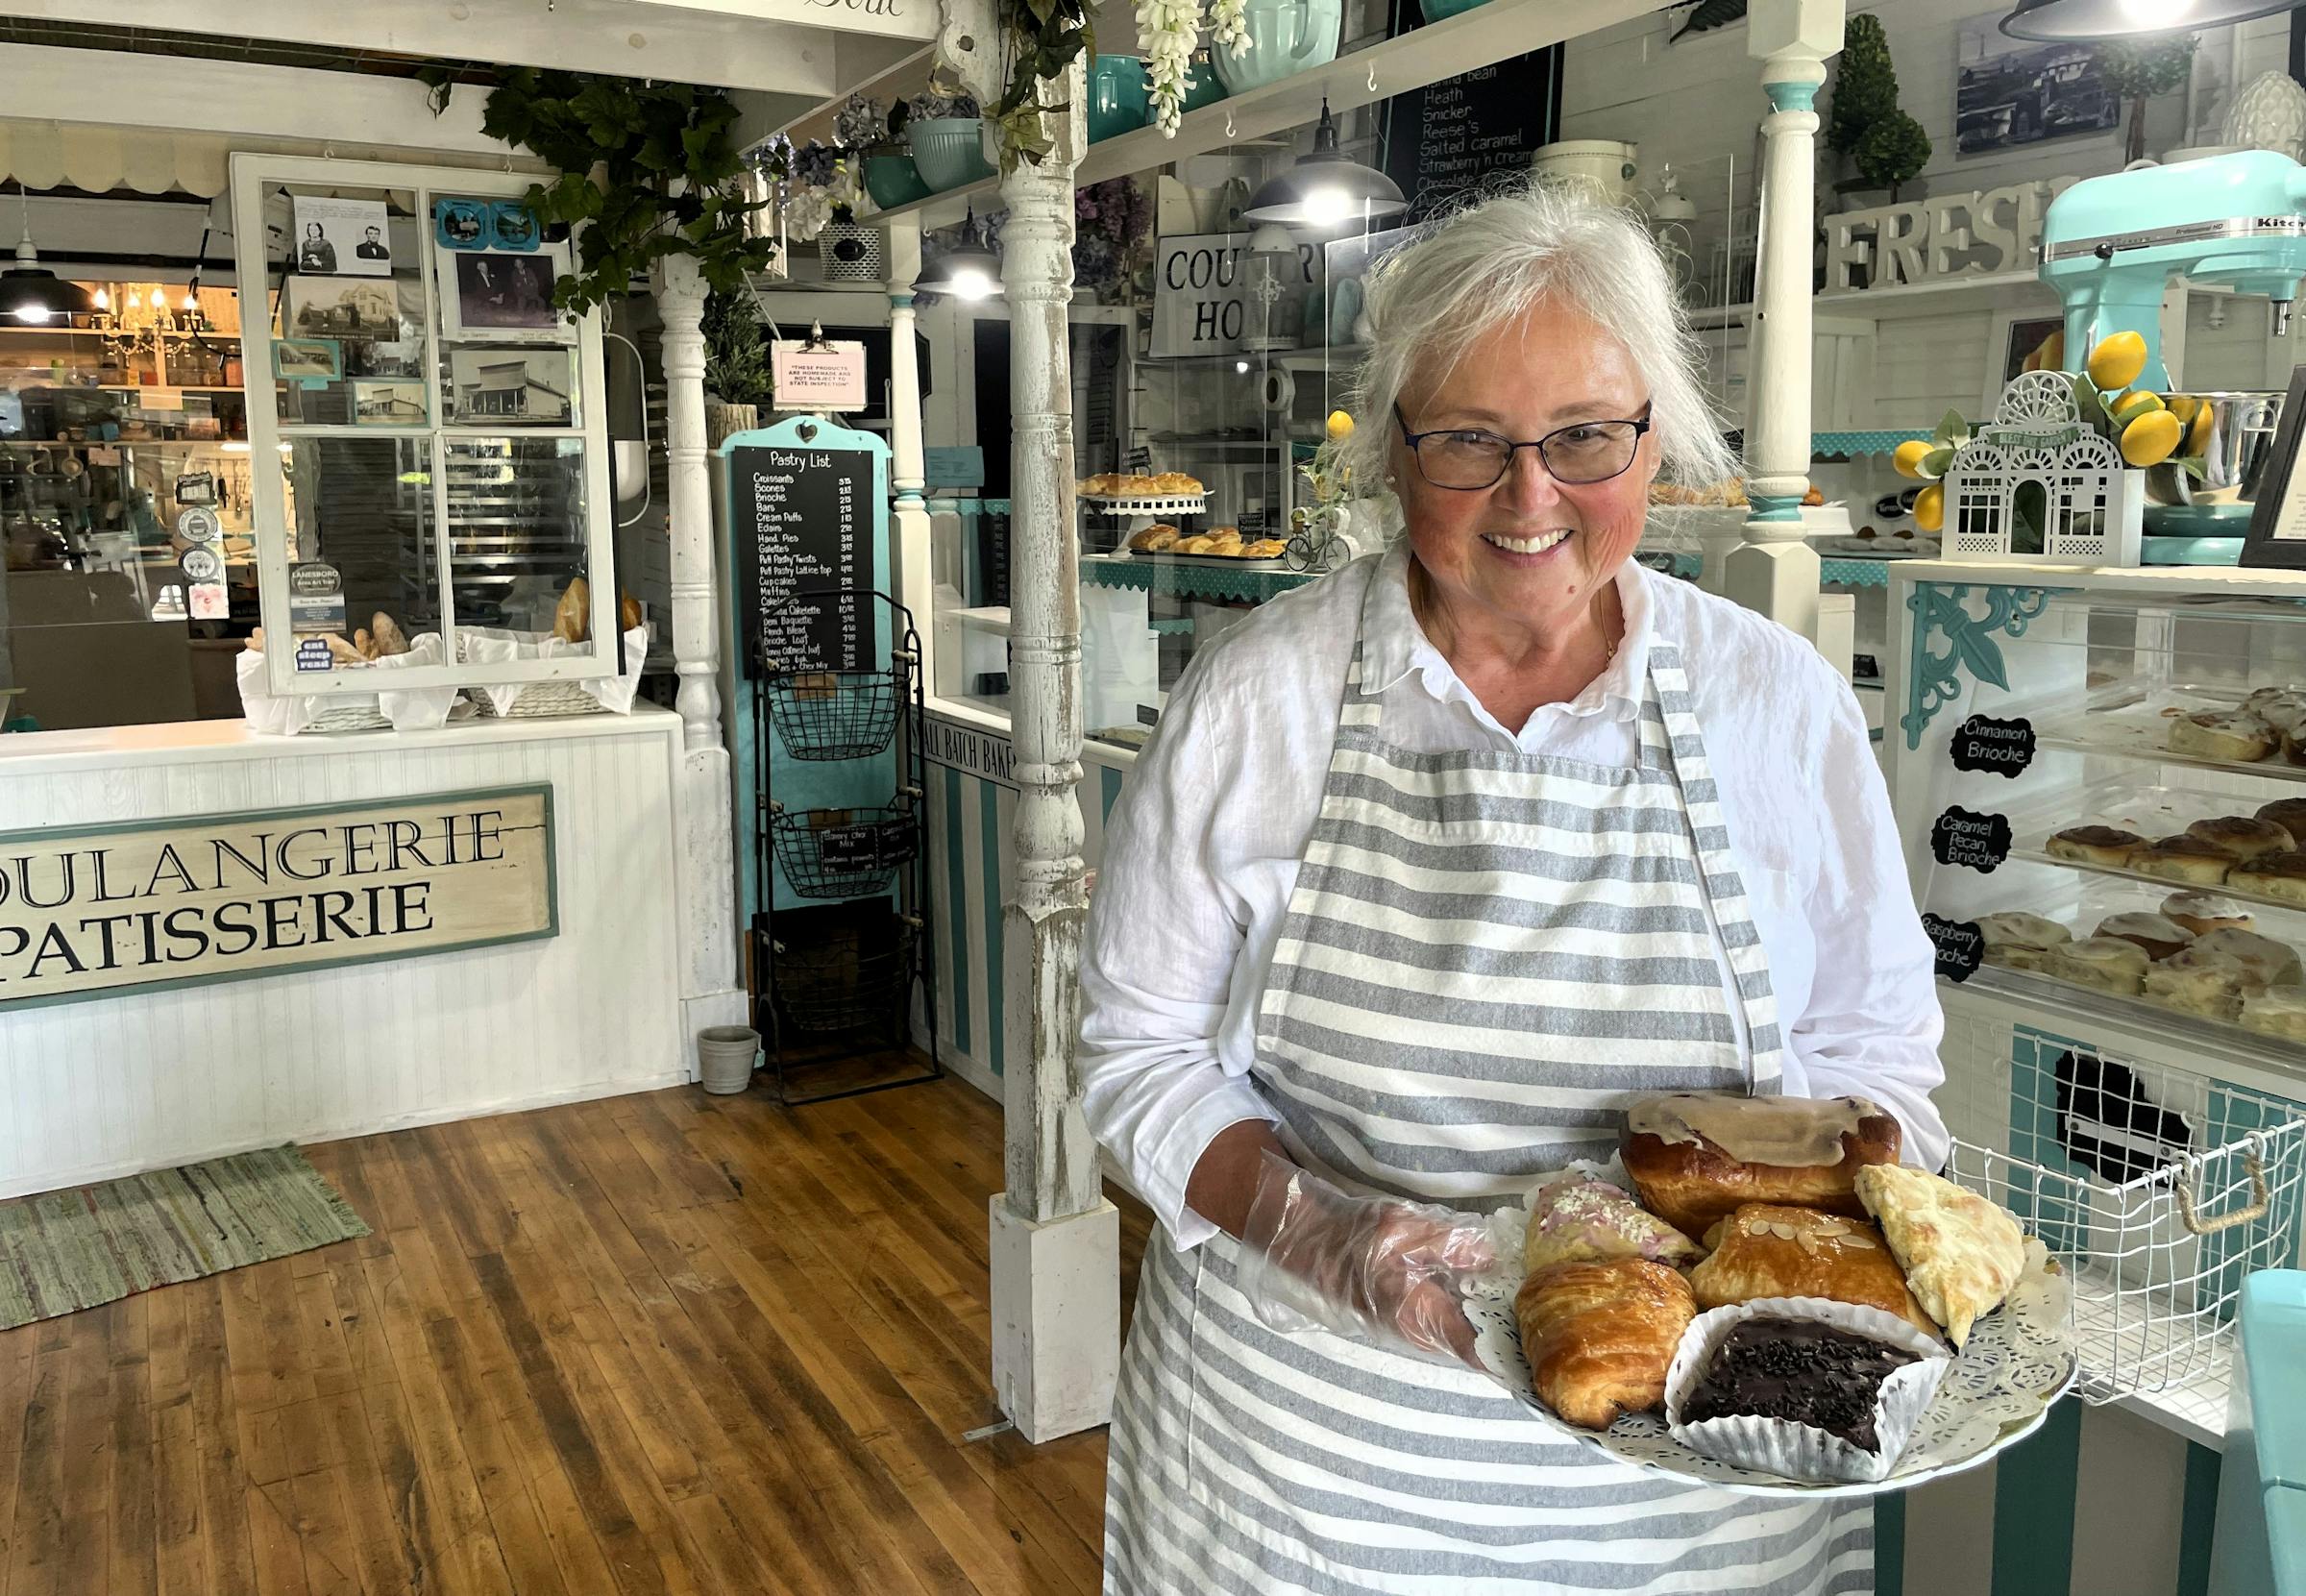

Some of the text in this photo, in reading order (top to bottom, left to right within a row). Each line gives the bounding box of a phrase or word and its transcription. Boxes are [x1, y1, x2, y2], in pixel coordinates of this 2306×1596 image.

[1424, 87, 1463, 105] Heath
[1423, 106, 1472, 122] Snicker
[1420, 139, 1465, 157] Salted
[1418, 156, 1480, 175] Strawberry
[1820, 176, 2081, 296] FRESH
[770, 451, 832, 473] Pastry List
[753, 472, 795, 484] Croissants
[754, 482, 786, 493] Scones
[755, 493, 787, 502] Brioche
[756, 503, 775, 512] Bars
[756, 513, 782, 522] Cream
[783, 512, 803, 522] Puffs
[757, 523, 782, 532] Eclairs
[782, 533, 799, 543] Pies
[758, 544, 790, 553] Galettes
[759, 554, 772, 564] Puff
[773, 554, 794, 566] Pastry
[794, 553, 817, 563] Twists
[291, 570, 339, 579] LANESBORO
[760, 566, 773, 576] Puff
[773, 566, 795, 577] Pastry
[796, 565, 819, 575] Lattice
[820, 564, 832, 577] top
[758, 577, 797, 586] Cupcakes
[760, 587, 790, 596] Muffins
[763, 627, 783, 636] French
[763, 637, 787, 647] Brioche
[792, 634, 809, 646] Loaf
[298, 651, 331, 660] sleep
[781, 646, 806, 654] Oatmeal
[300, 660, 330, 669] read
[1964, 720, 2027, 742] Cinnamon
[911, 721, 1017, 780] SALL BATCH BAKE
[1967, 742, 2026, 763] Brioche
[1941, 816, 1993, 836] Caramel
[1950, 833, 1986, 852] Pecan
[0, 811, 503, 909] ULANGERIE
[1948, 847, 1999, 866] Brioche
[1923, 918, 1978, 950] Raspberry
